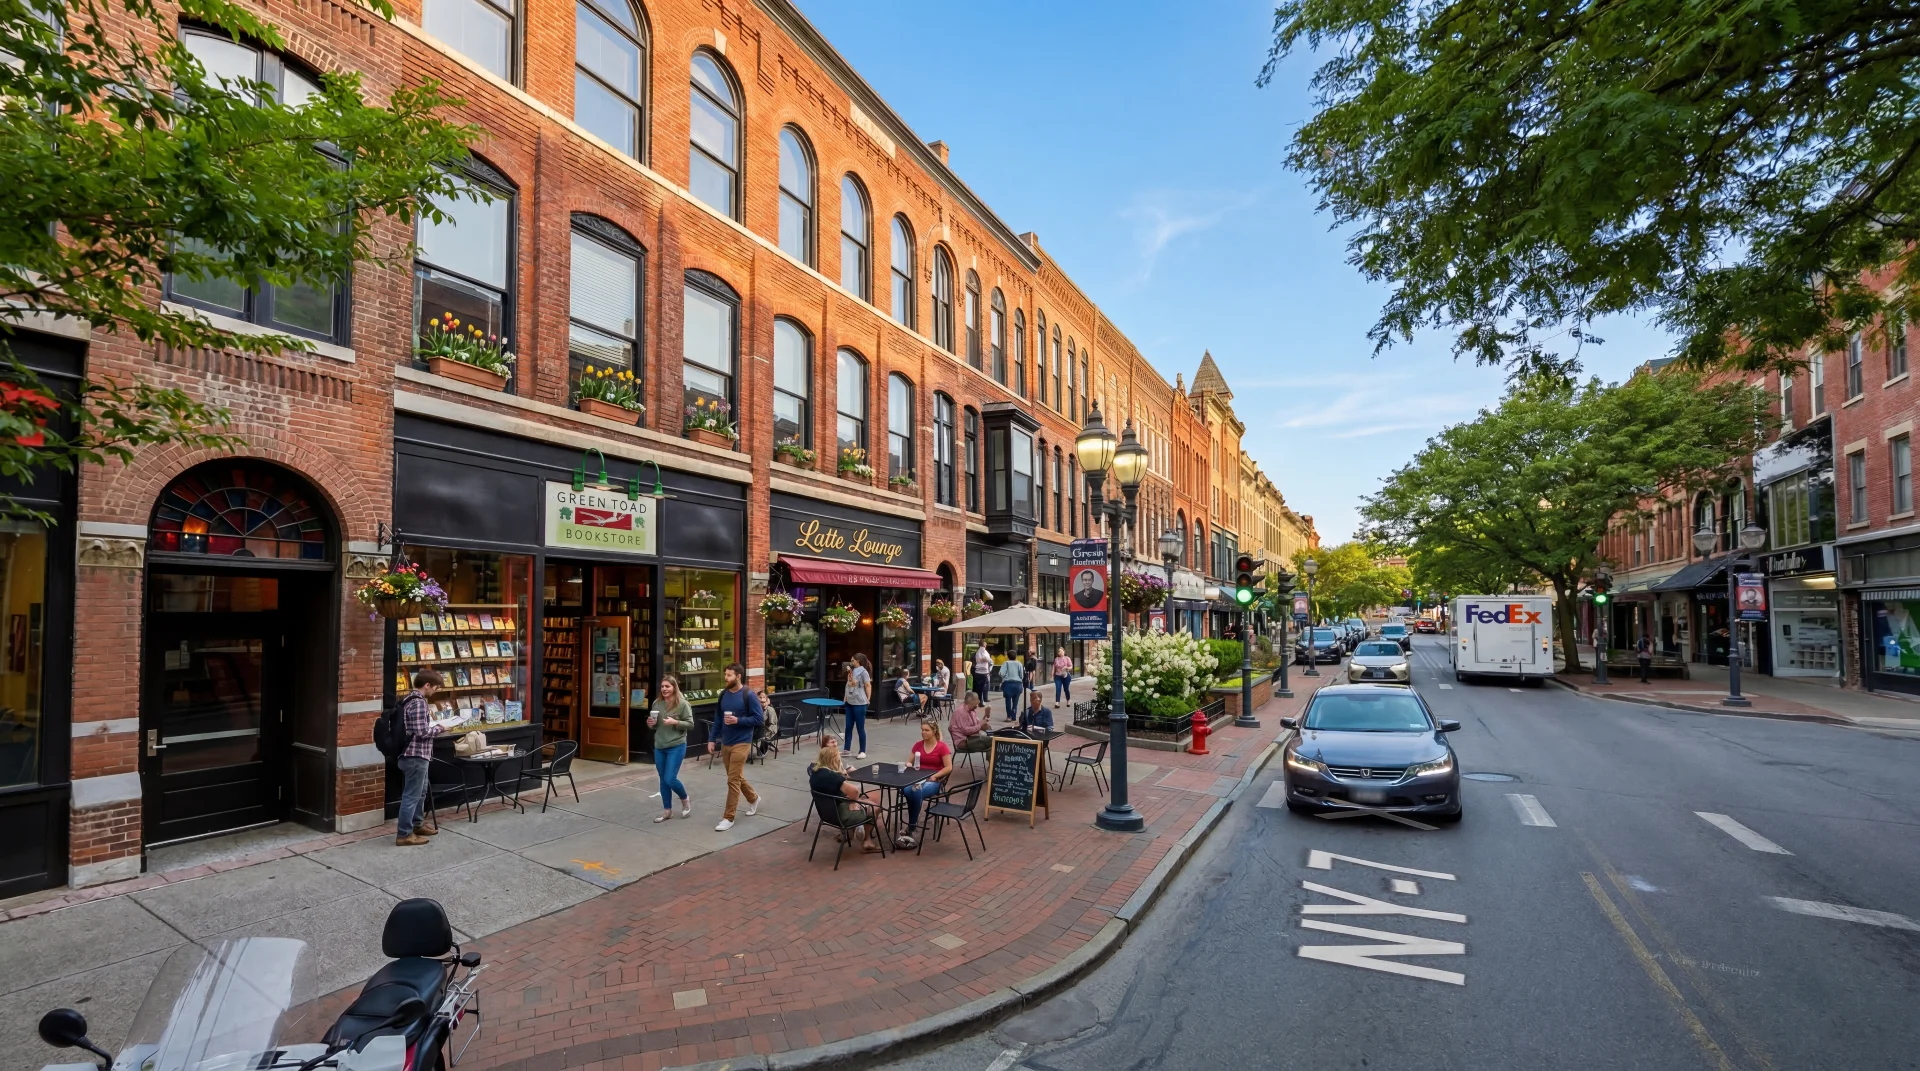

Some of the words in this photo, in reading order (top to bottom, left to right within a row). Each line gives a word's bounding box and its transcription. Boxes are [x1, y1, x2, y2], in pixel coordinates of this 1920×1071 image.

[557, 491, 606, 508] GREEN
[611, 499, 647, 514] TOAD
[566, 528, 641, 545] BOOKSTORE
[795, 519, 845, 553] Latte
[848, 528, 903, 563] Lounge
[1466, 604, 1542, 624] FedEx
